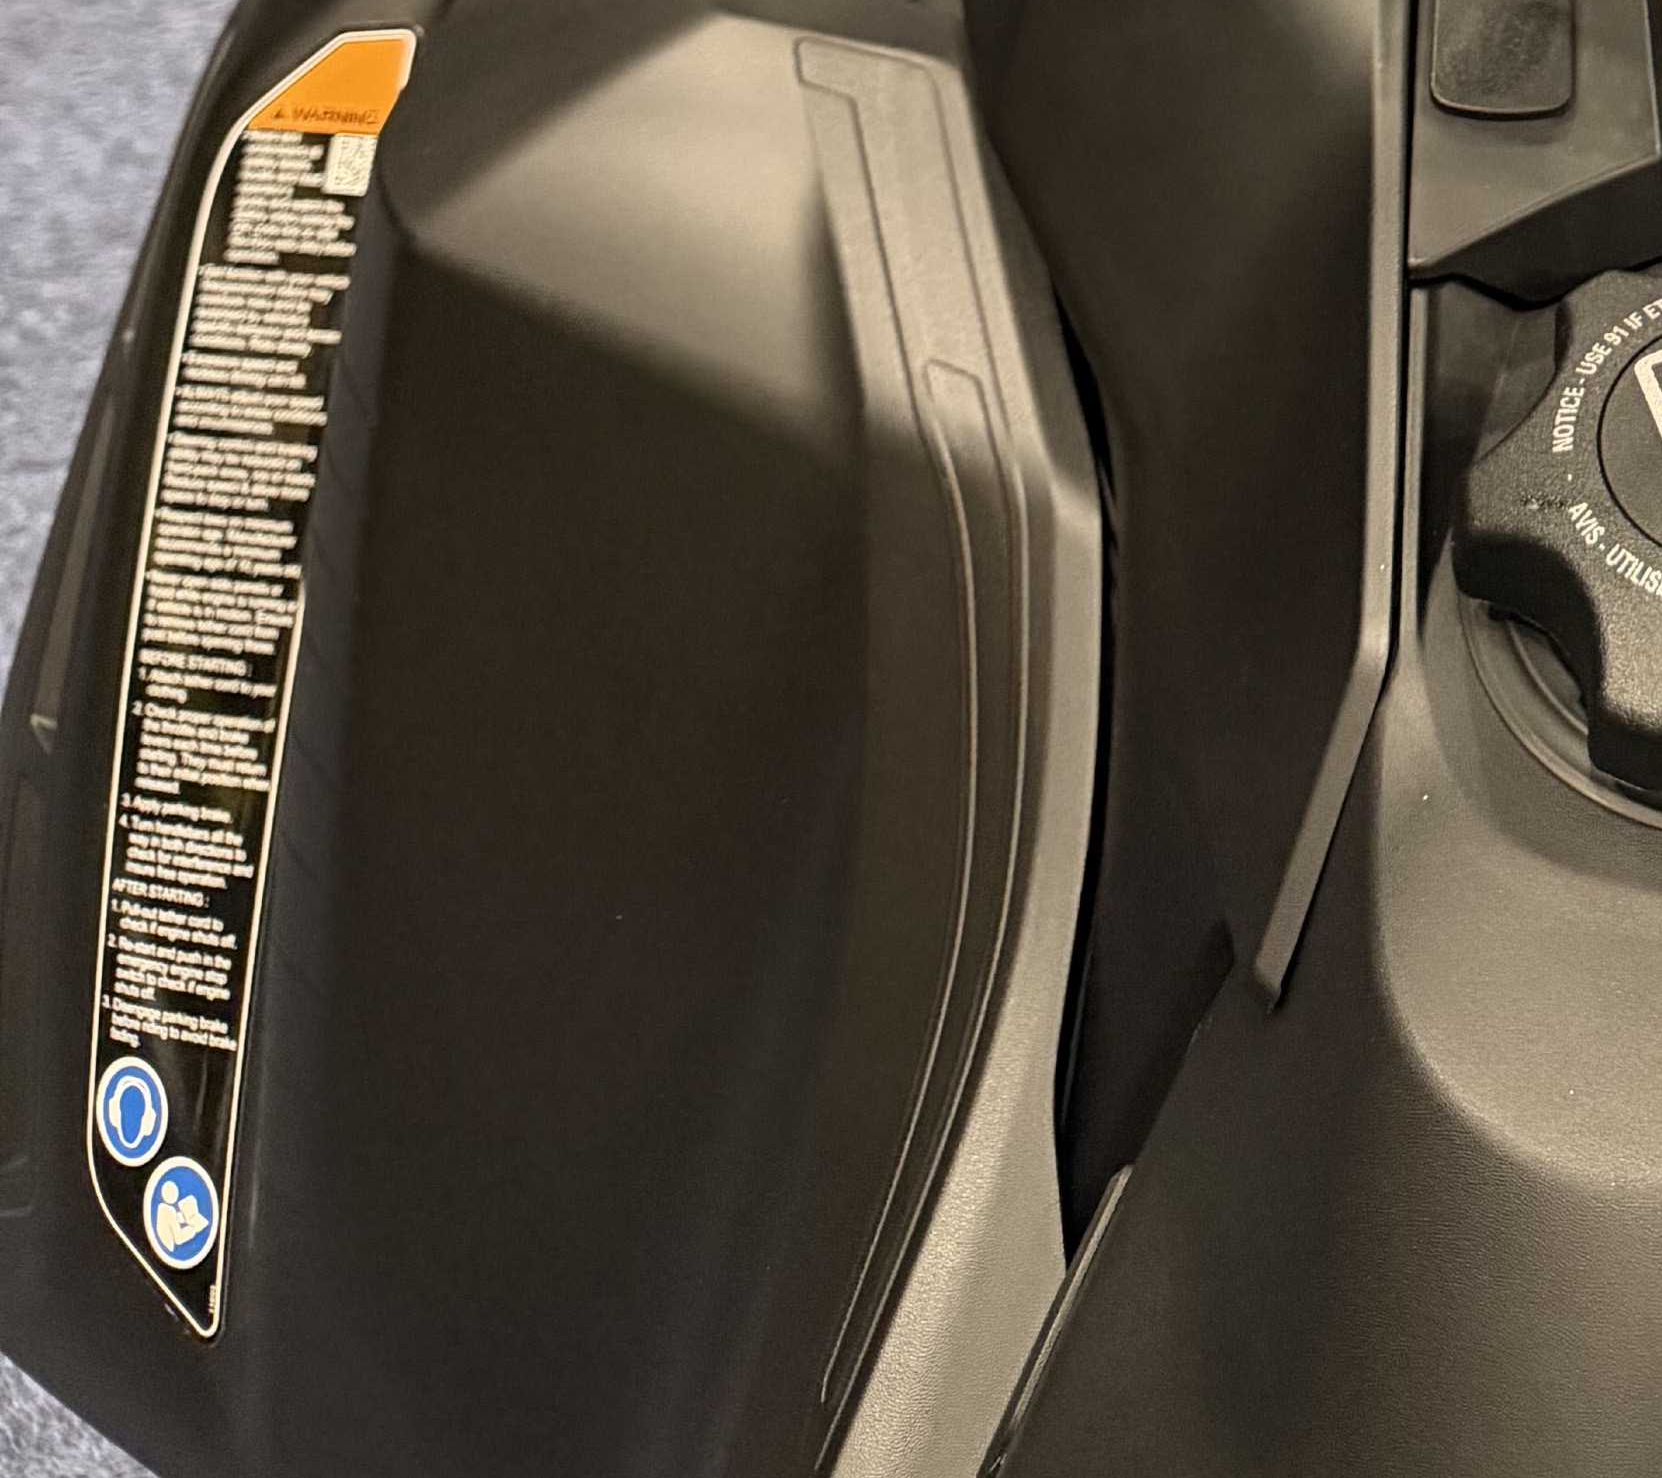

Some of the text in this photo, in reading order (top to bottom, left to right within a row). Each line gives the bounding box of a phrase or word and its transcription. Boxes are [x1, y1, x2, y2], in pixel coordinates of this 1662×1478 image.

[1552, 386, 1585, 453] NOTICE
[1575, 342, 1612, 375] USE
[1603, 325, 1629, 346] 91
[1624, 311, 1644, 331] IF
[1568, 502, 1605, 545] AVIS
[139, 648, 187, 668] BEFORE
[188, 654, 246, 676] STARTING
[112, 877, 149, 897] AFTER
[149, 883, 204, 907] STARTING
